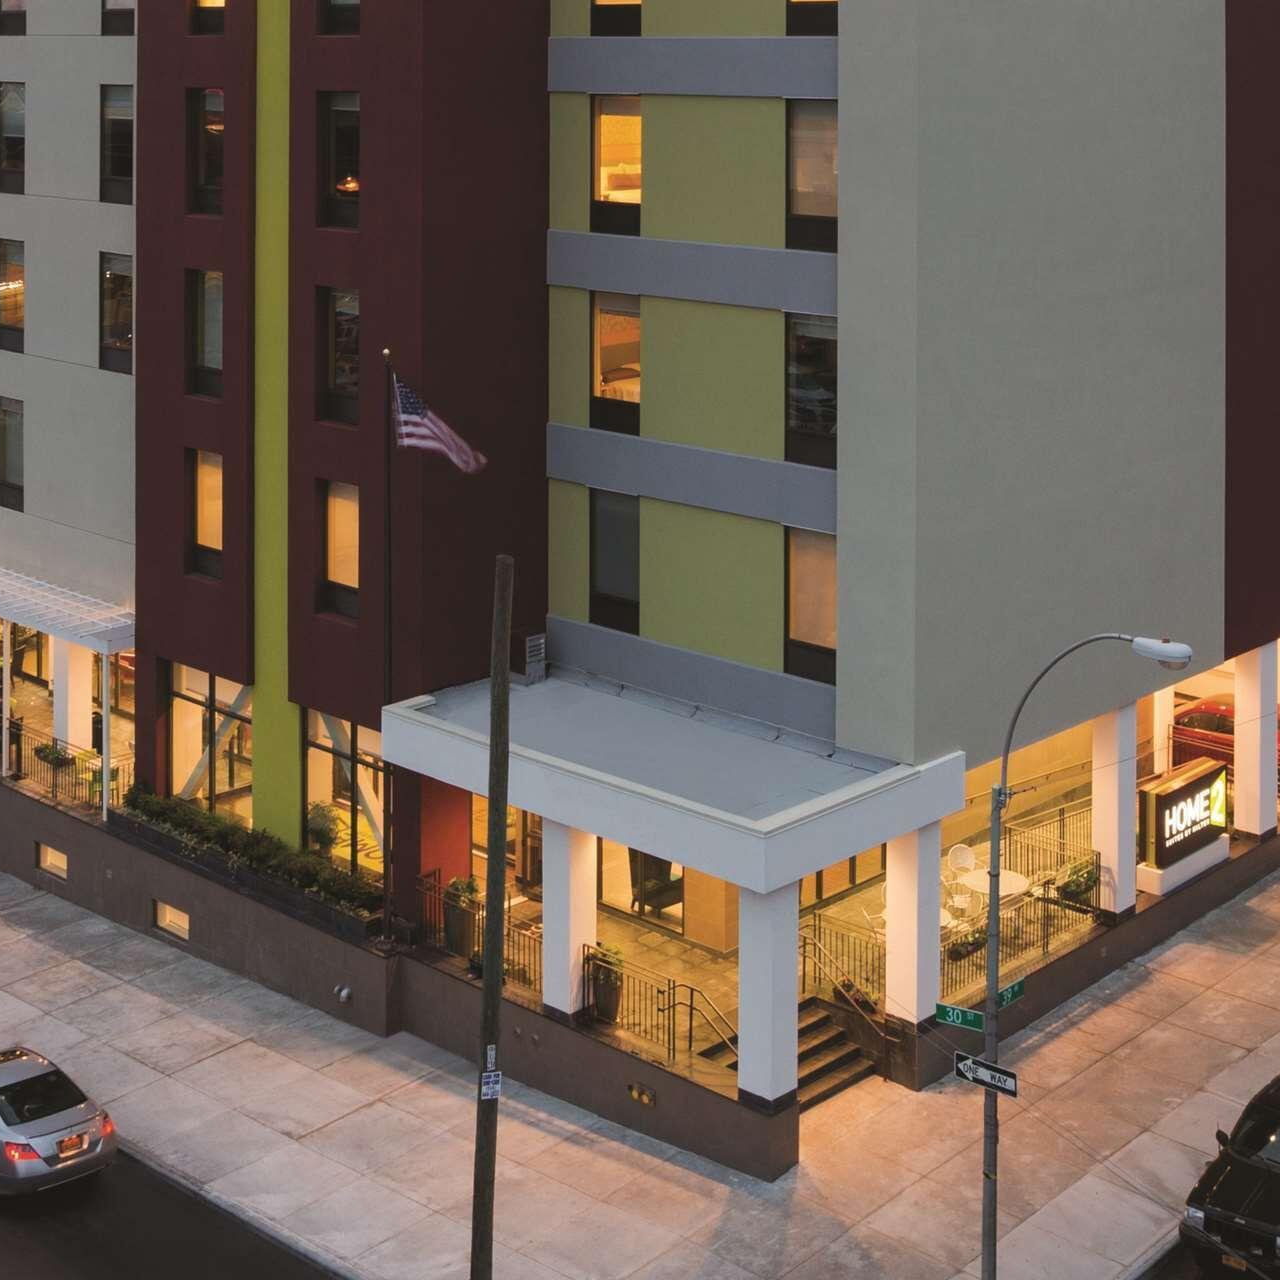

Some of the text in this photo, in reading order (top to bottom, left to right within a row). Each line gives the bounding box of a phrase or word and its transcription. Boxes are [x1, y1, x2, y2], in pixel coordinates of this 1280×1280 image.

[946, 1007, 962, 1024] 30
[963, 1064, 1008, 1087] ONE WAY
